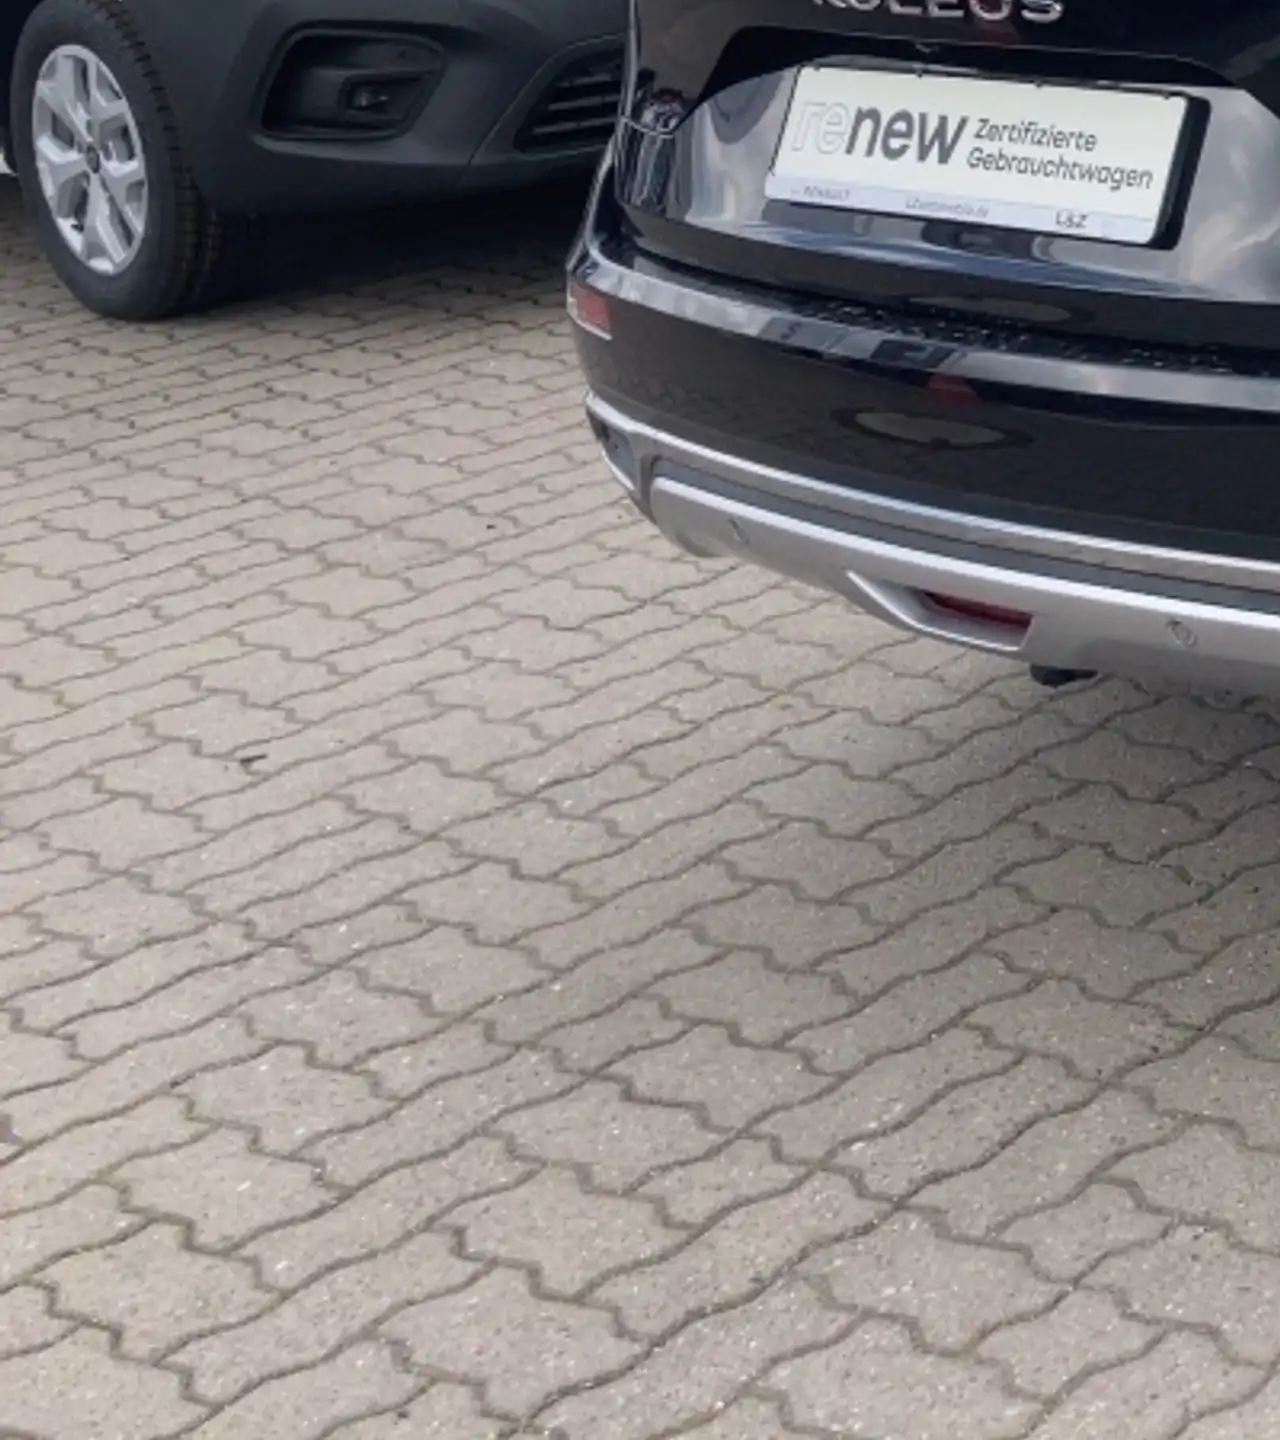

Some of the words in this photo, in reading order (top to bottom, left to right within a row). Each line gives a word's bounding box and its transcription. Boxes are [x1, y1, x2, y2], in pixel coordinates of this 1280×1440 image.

[790, 99, 968, 166] renew
[973, 117, 1098, 152] Zertifizierte
[966, 146, 1154, 191] Gebrauchtwagen
